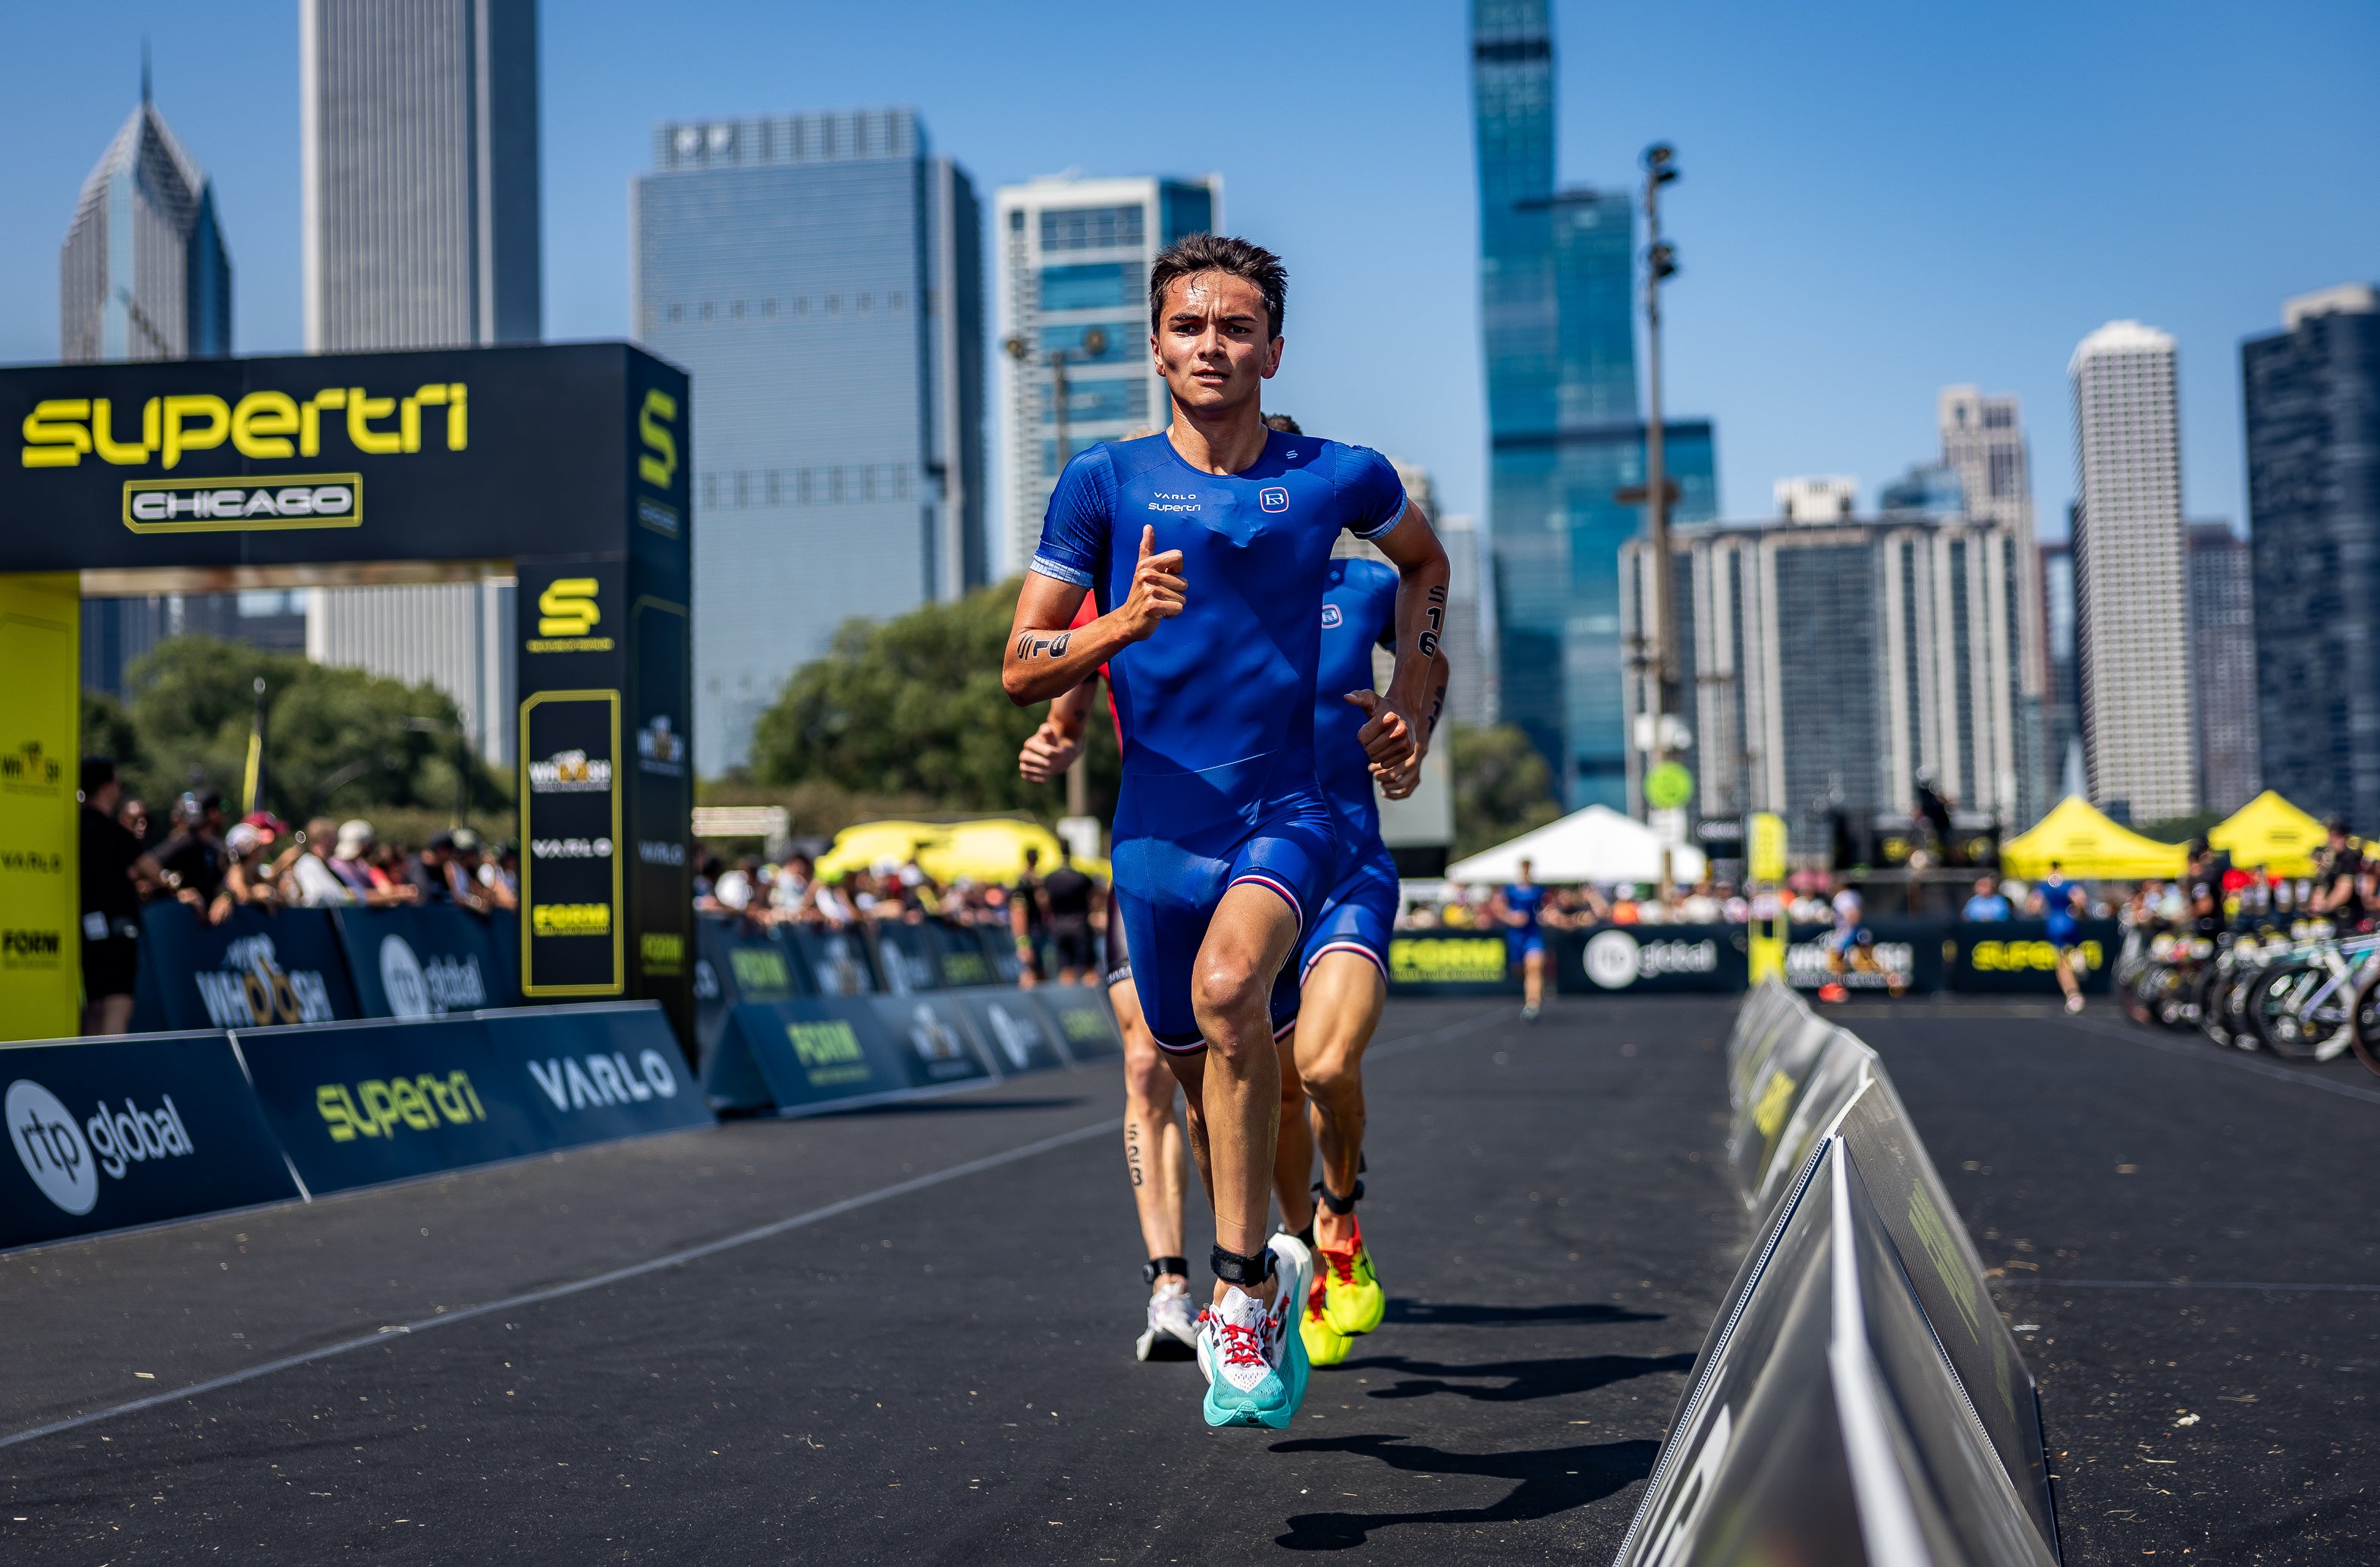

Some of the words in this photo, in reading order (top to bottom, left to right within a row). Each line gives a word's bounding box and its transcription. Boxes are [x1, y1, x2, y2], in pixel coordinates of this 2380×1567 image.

[132, 485, 353, 521] CHICAGO
[1154, 491, 1197, 500] VARLO
[531, 837, 614, 859] VARLO
[2, 928, 61, 956] FORM
[195, 968, 334, 1028] WHOOSH
[527, 1047, 678, 1113] VARLO
[20, 1107, 81, 1185] rtp
[88, 1094, 195, 1181] global
